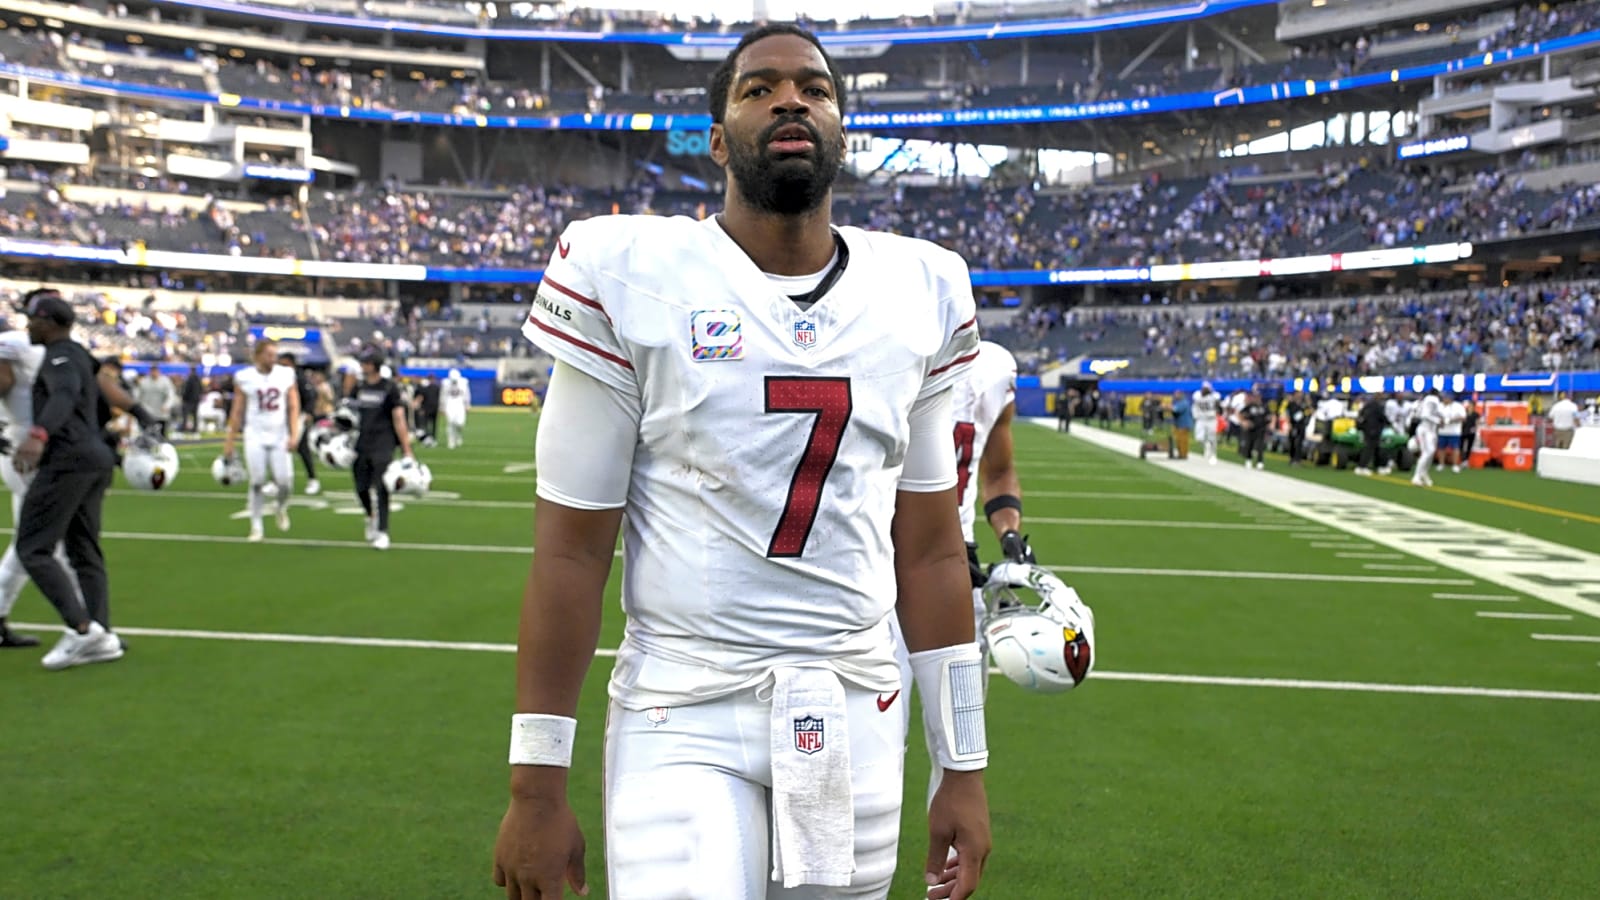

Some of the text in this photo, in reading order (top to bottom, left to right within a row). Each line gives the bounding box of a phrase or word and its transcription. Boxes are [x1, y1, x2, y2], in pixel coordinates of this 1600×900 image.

[797, 331, 814, 344] NFL
[256, 387, 280, 411] 12
[764, 376, 852, 558] 7
[797, 732, 822, 751] NFL
